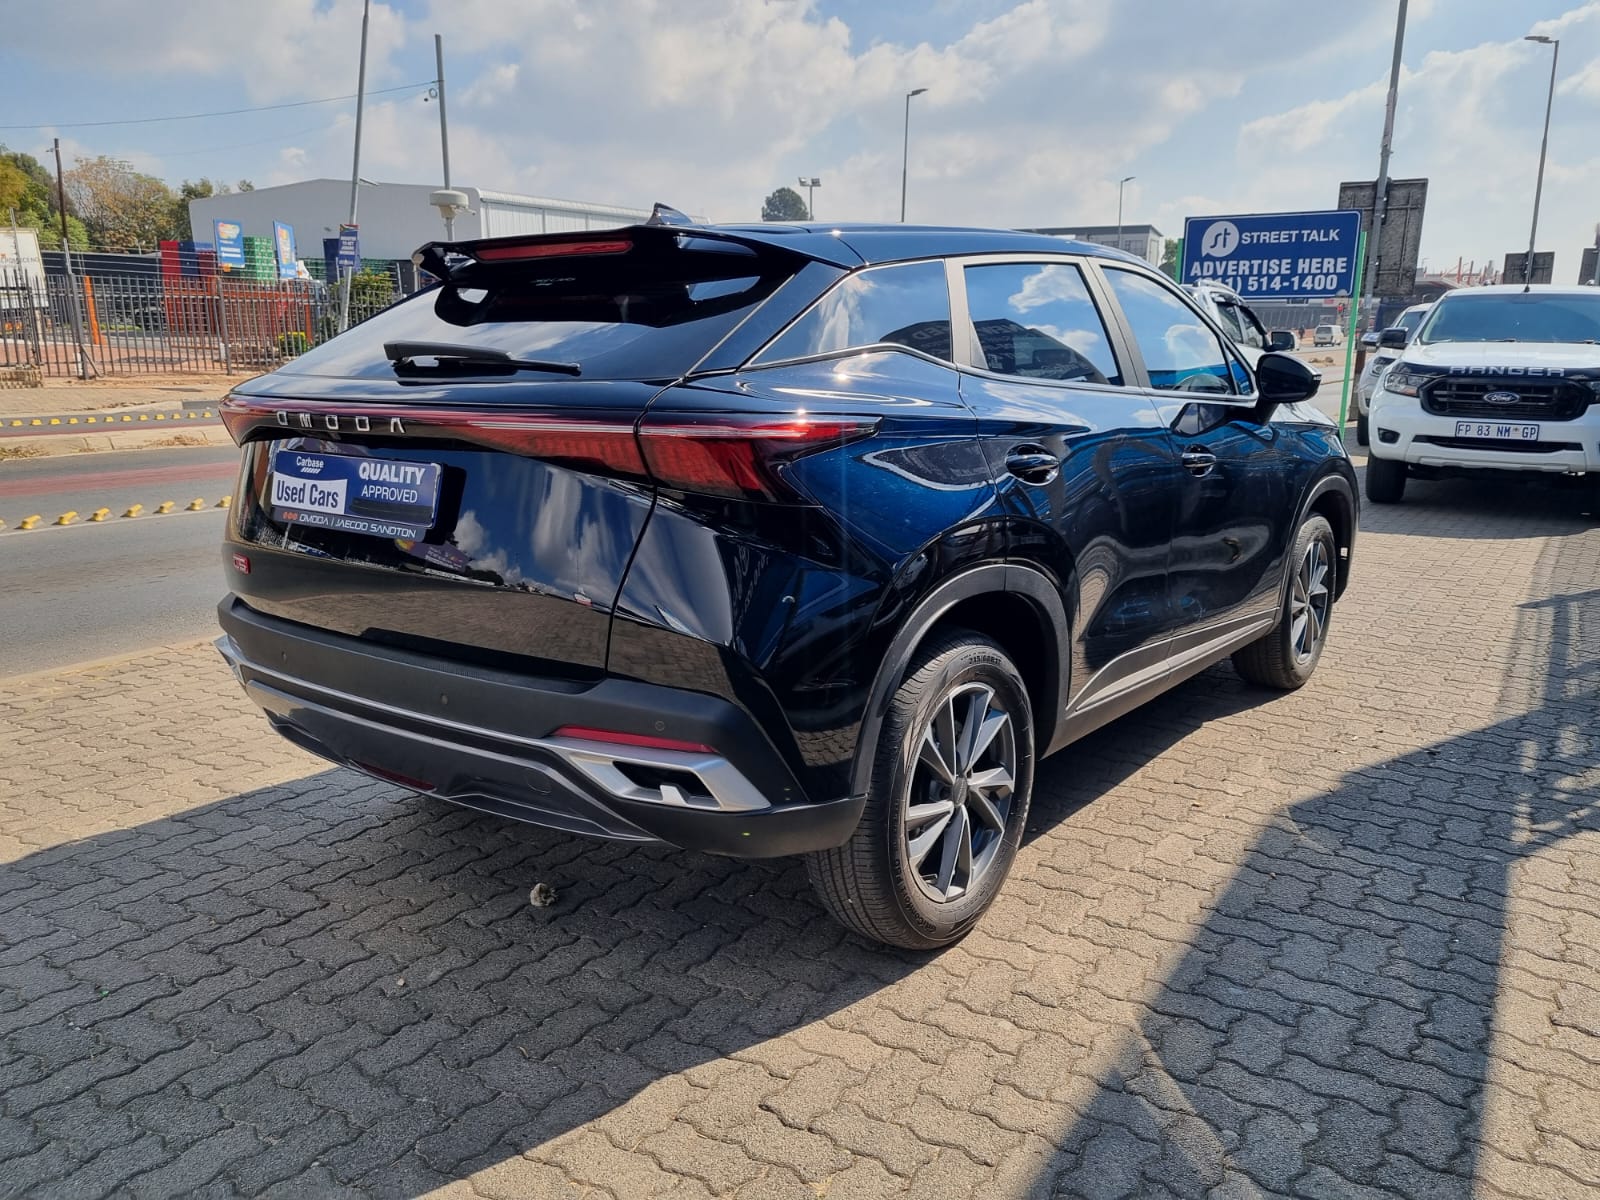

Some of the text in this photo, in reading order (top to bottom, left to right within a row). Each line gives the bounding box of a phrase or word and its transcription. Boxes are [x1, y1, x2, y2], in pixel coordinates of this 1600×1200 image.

[1241, 228, 1340, 245] STREET TALK
[1190, 256, 1348, 277] ADVERTISE HERE
[1247, 273, 1338, 292] 514-1400
[1449, 366, 1565, 377] RANGER
[1457, 423, 1537, 439] FP 83 NM GP
[295, 455, 325, 469] Carbase
[358, 461, 426, 486] QUALITY
[276, 478, 339, 509] Used Cars
[361, 484, 418, 504] APPROVED
[369, 523, 417, 539] SANDTON
